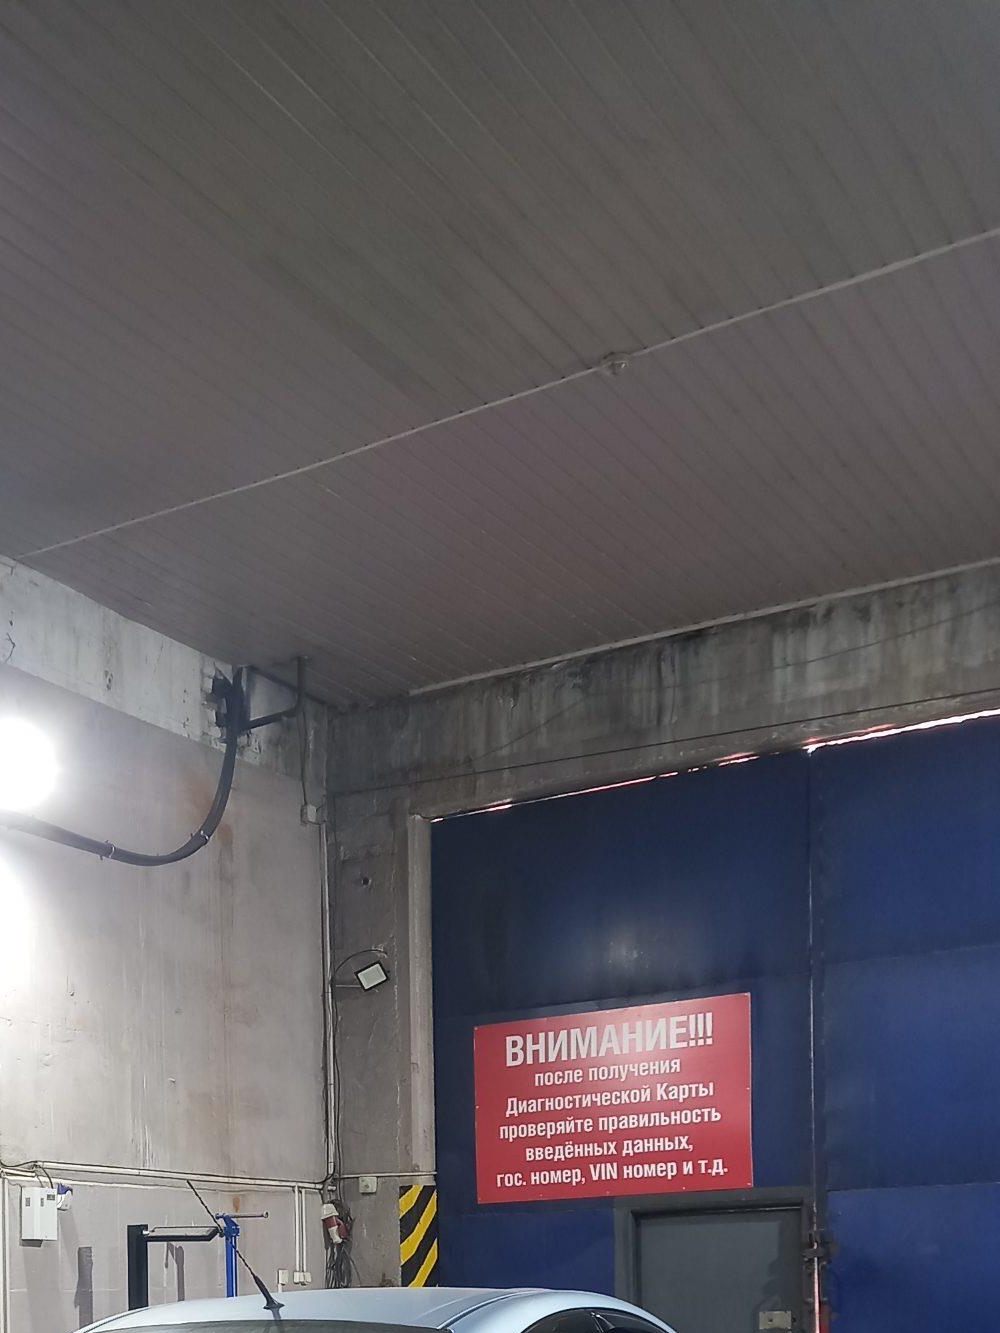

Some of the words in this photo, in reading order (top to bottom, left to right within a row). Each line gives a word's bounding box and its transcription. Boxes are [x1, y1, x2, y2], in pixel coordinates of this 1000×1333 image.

[505, 1012, 714, 1067] ВНИМАНИЕ!!!
[534, 1069, 583, 1087] после
[588, 1059, 681, 1083] получения
[505, 1085, 651, 1117] Диагностической
[656, 1081, 714, 1102] Карты
[499, 1117, 593, 1142] проверяйте
[598, 1107, 721, 1133] правильность
[525, 1141, 617, 1162] введённых
[621, 1135, 693, 1157] данных,
[496, 1172, 526, 1188] гос.
[530, 1167, 585, 1185] номер,
[589, 1162, 618, 1181] VIN
[622, 1161, 677, 1181] номер
[682, 1160, 693, 1175] и
[697, 1158, 728, 1175] т.д.
